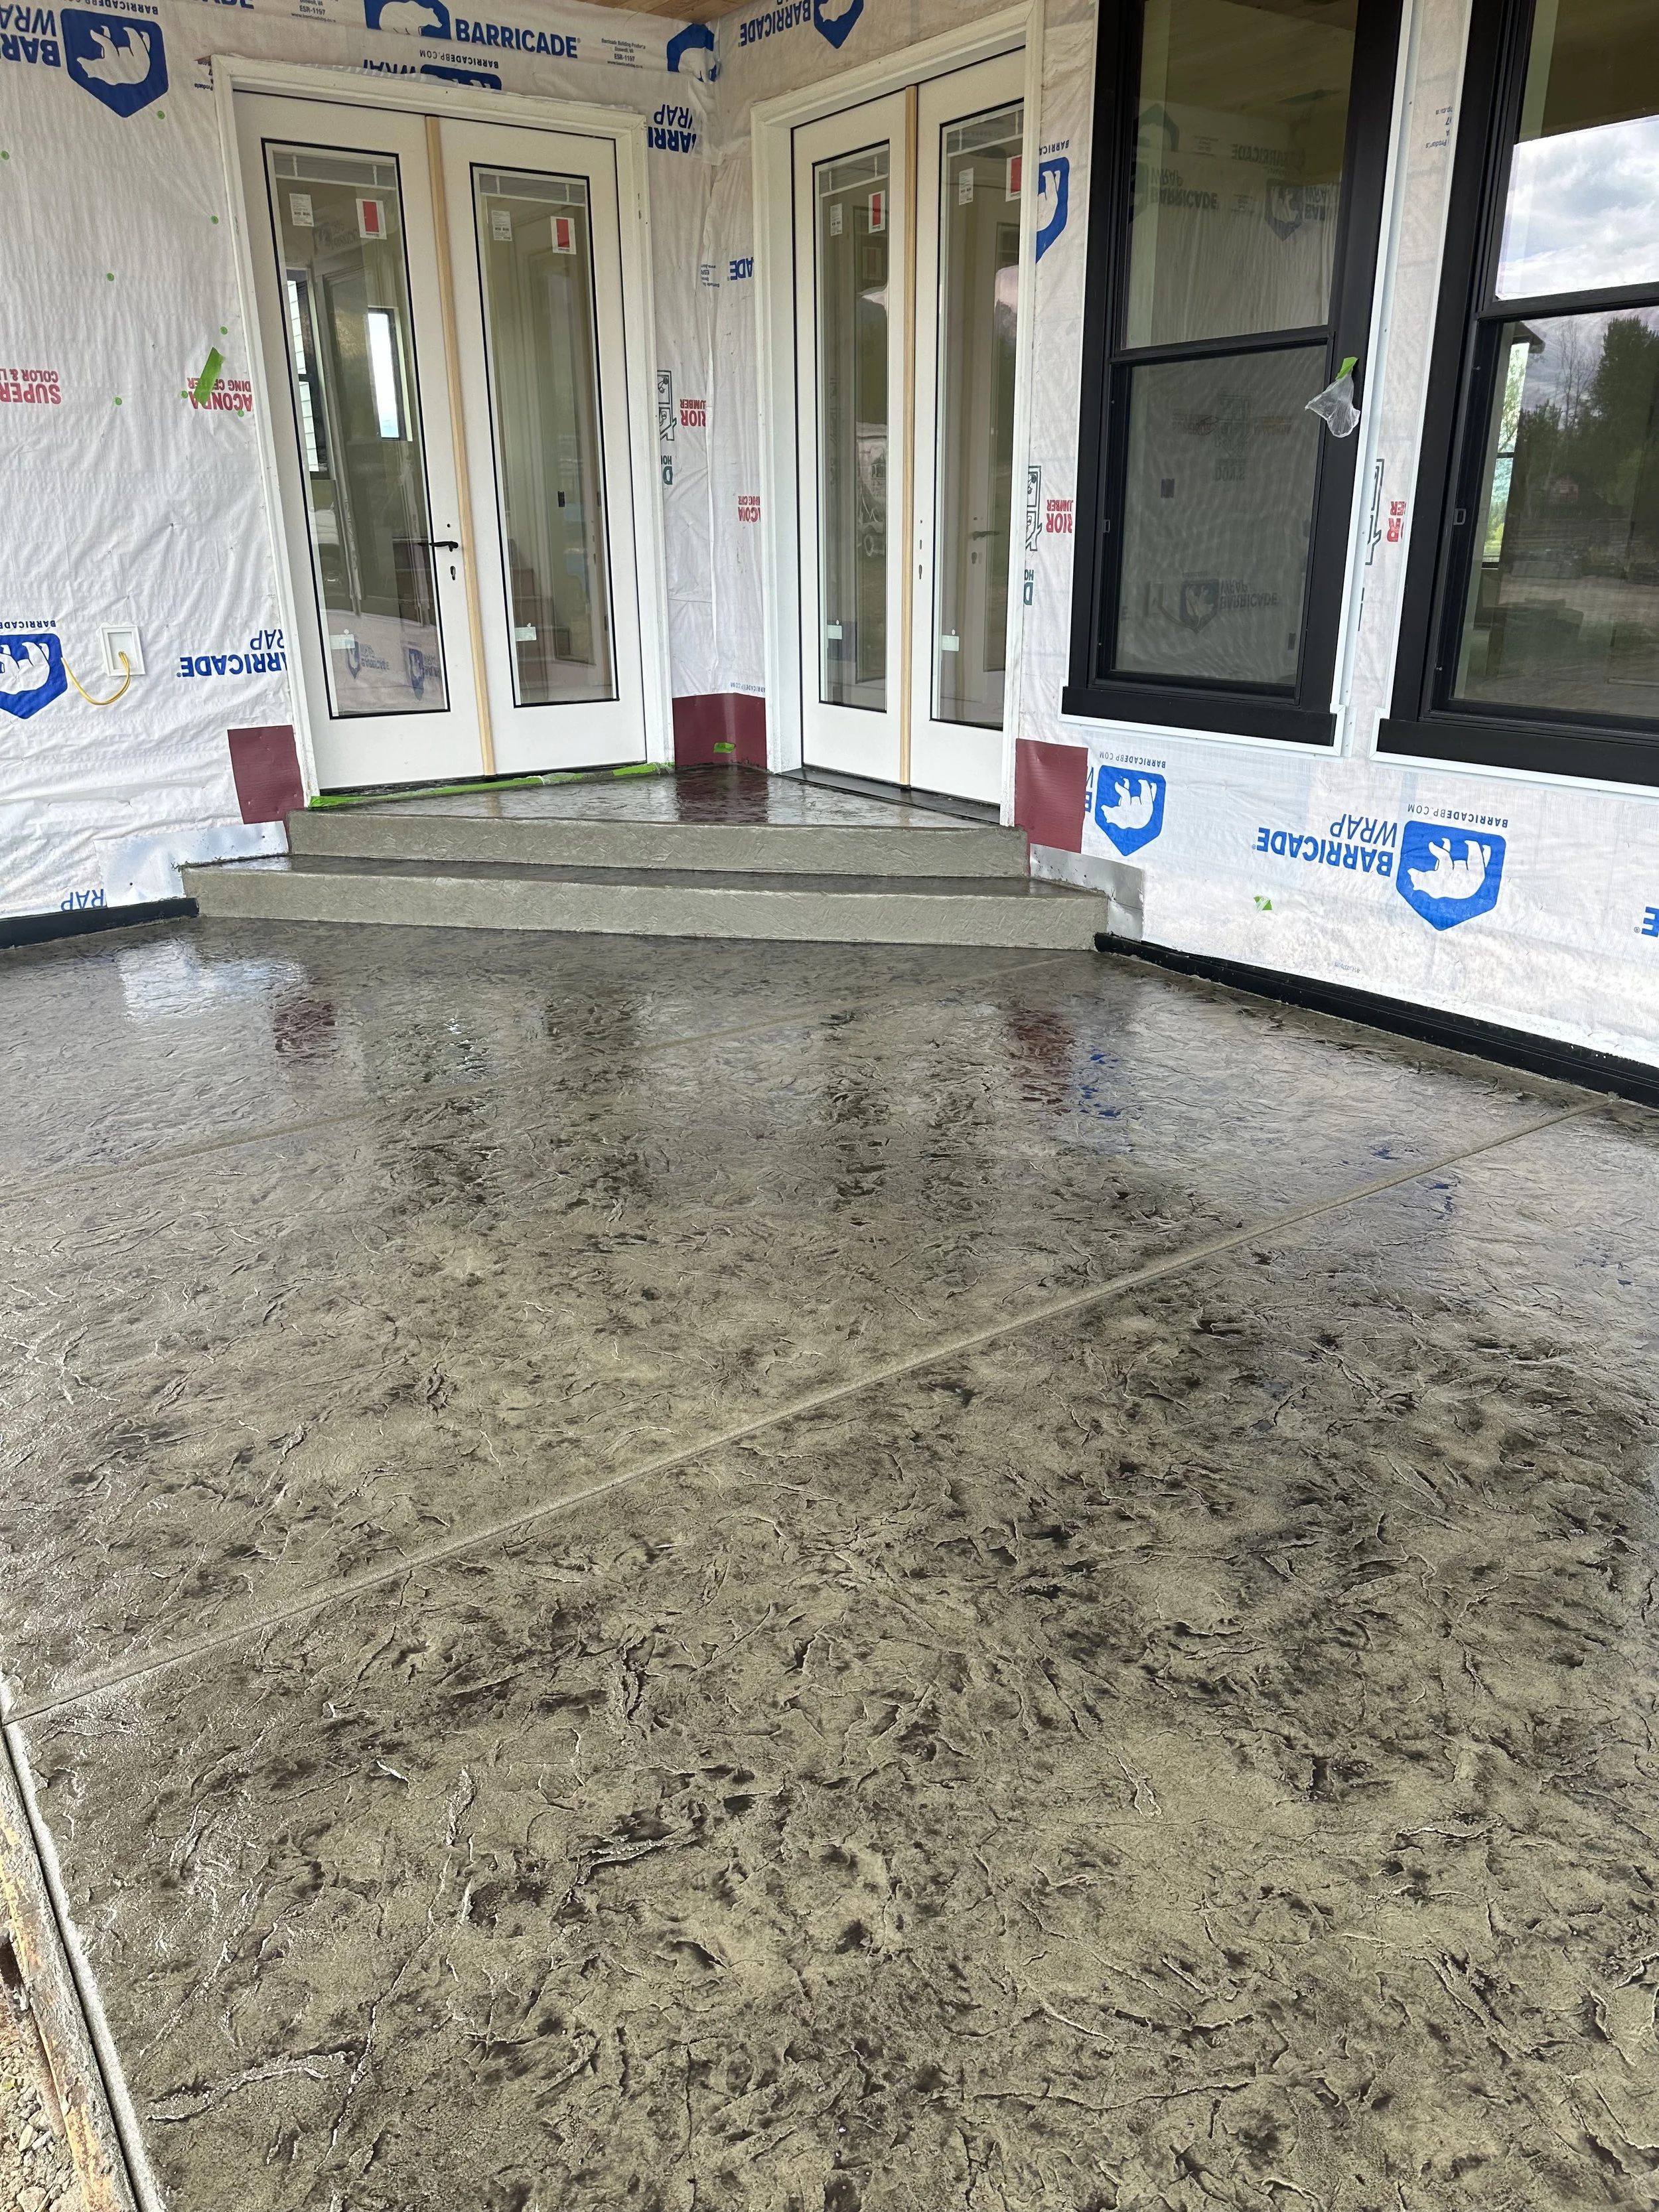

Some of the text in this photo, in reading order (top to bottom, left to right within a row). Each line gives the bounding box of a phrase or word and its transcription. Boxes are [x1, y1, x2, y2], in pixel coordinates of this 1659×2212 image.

[299, 5, 325, 15] ESR-1197
[740, 1, 811, 47] BARRICADE
[456, 19, 579, 58] BARRICADE
[0, 34, 61, 68] BAR
[419, 50, 499, 68] BARRICADEBP.COM
[9, 369, 19, 381] &
[21, 369, 58, 383] COLOR
[187, 378, 252, 392] DING CEER
[0, 382, 61, 404] SUPER
[1407, 803, 1508, 828] BARRICADEBP.COM
[1330, 813, 1398, 848] WRAP
[1256, 828, 1394, 877] BARRICADE
